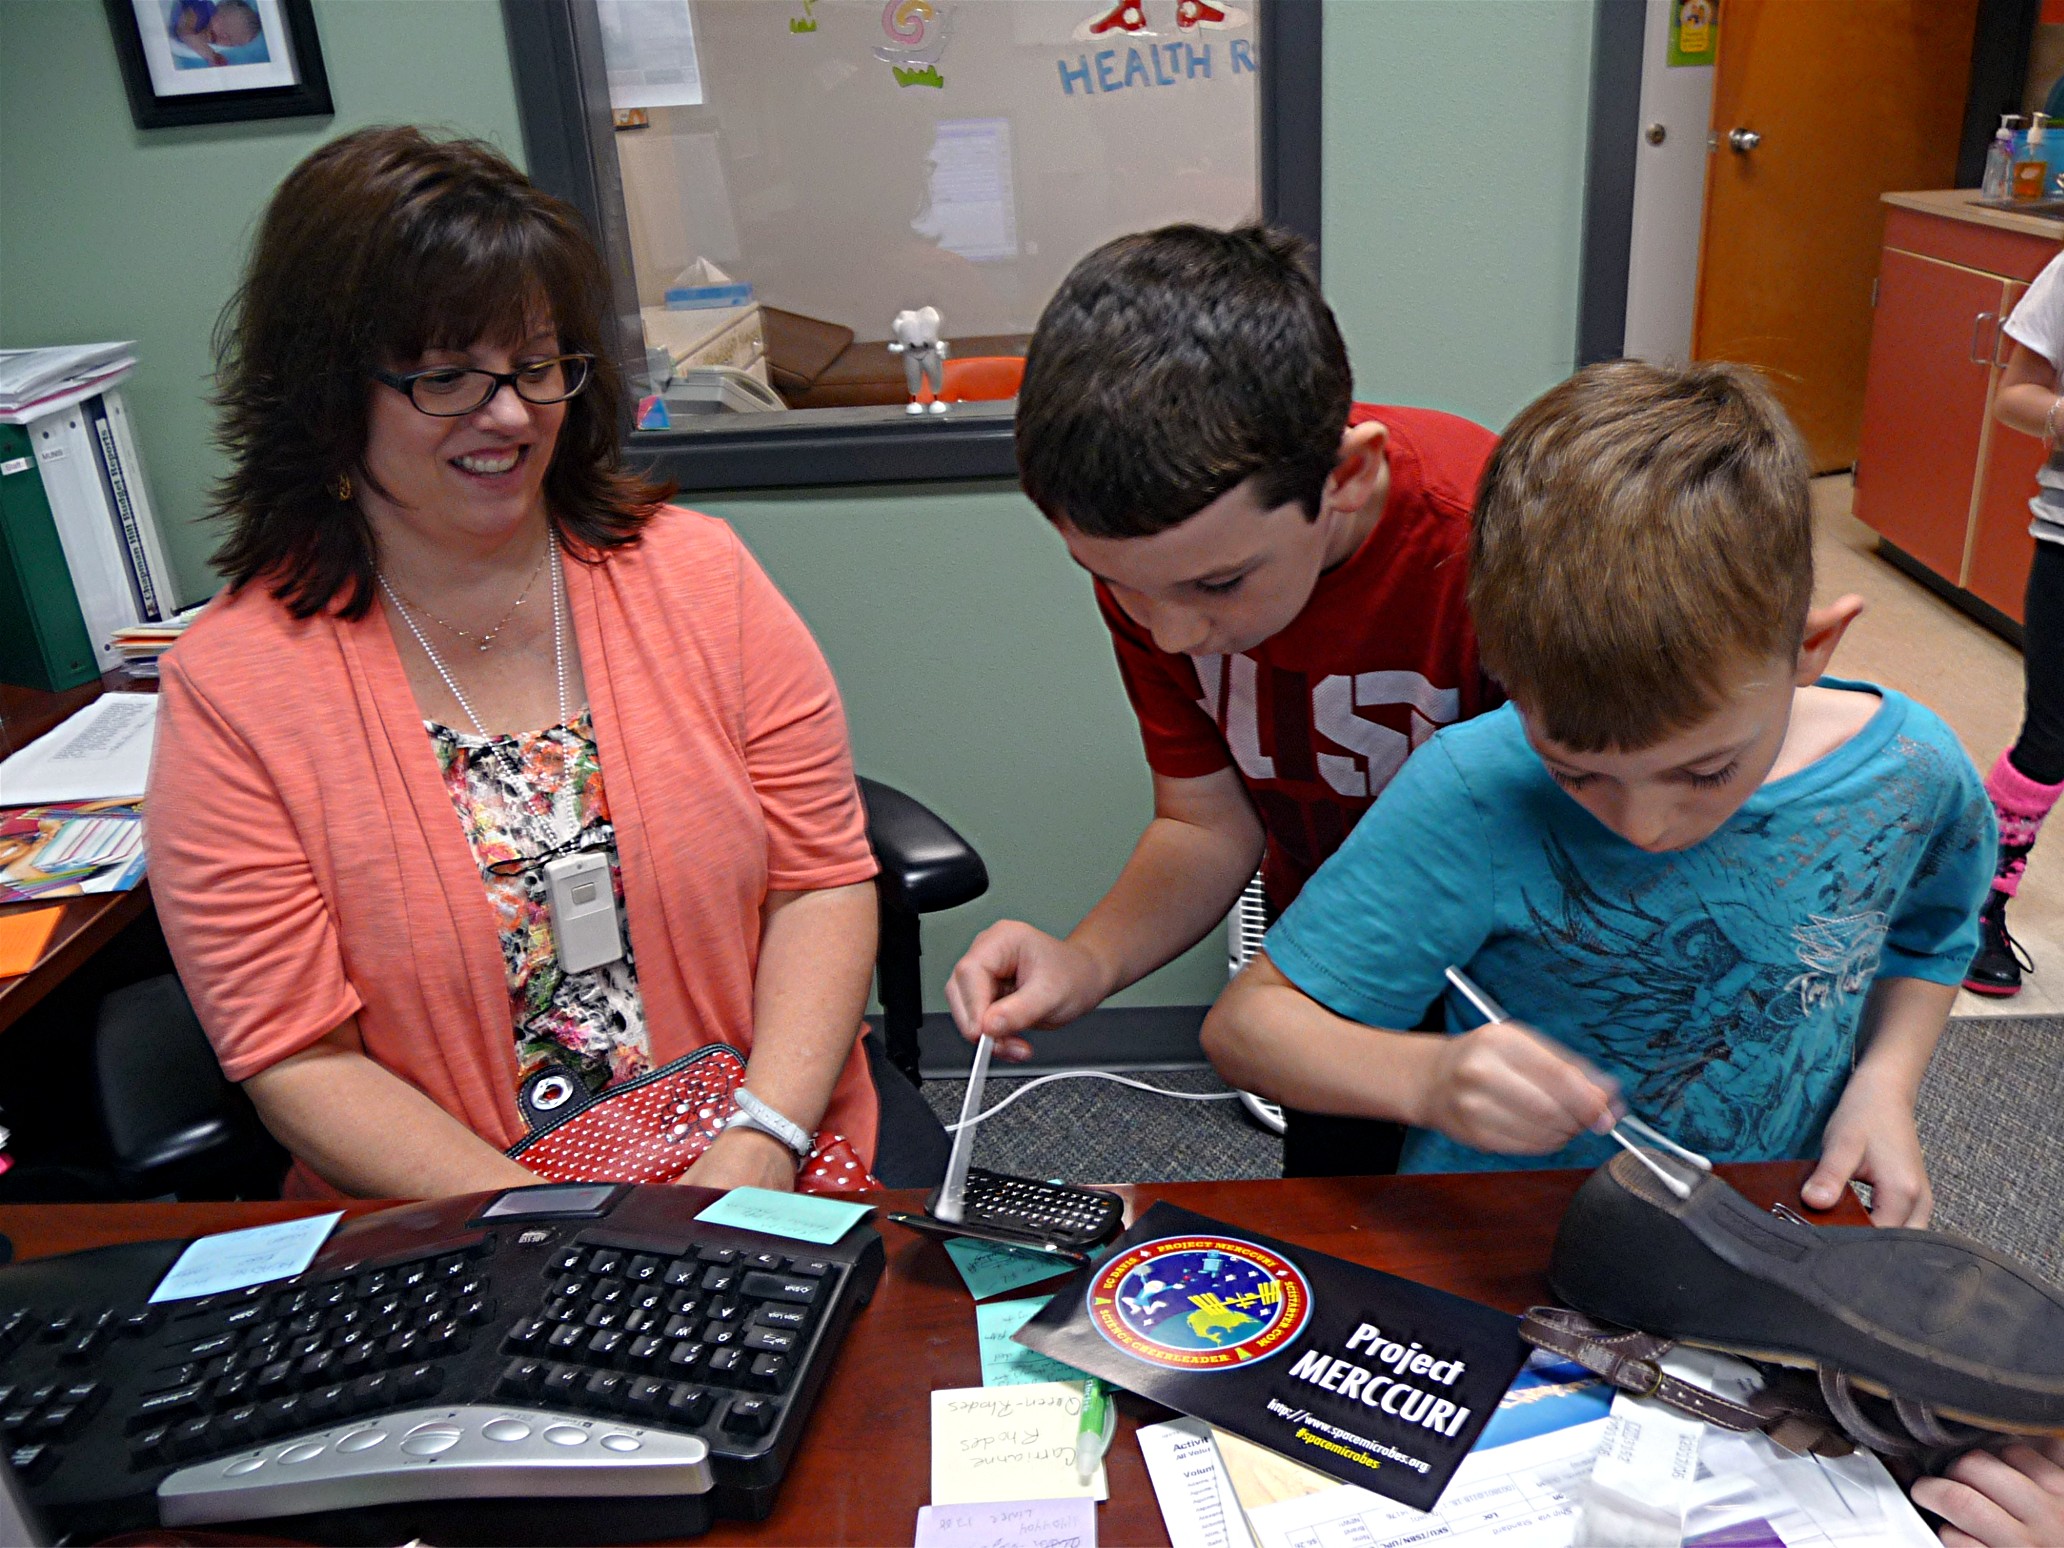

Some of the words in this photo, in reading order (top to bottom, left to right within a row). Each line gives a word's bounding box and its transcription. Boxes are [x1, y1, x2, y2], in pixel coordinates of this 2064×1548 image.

[1057, 41, 1211, 95] HEALTH
[101, 430, 118, 476] Reports
[113, 480, 130, 521] Budget
[124, 523, 137, 544] Hill
[133, 546, 152, 600] Chapman
[1113, 1256, 1139, 1279] DAVIS
[1156, 1241, 1213, 1252] PROJECT
[1214, 1242, 1278, 1269] MERCCURI
[1255, 1281, 1301, 1348] SCISTARTER.COM
[1100, 1309, 1142, 1344] SCIENCE
[1131, 1338, 1232, 1364] CHEERLEADER
[1345, 1323, 1466, 1386] Project
[1288, 1349, 1472, 1438] MERCCURI
[960, 1427, 1040, 1452] Rhodes
[1267, 1398, 1432, 1473] http://www.spacemicrobes.org
[1295, 1427, 1381, 1469] #spacemicrobes
[970, 1446, 1077, 1468] Carrianne
[1176, 1453, 1187, 1461] All
[1492, 1519, 1533, 1535] Standard
